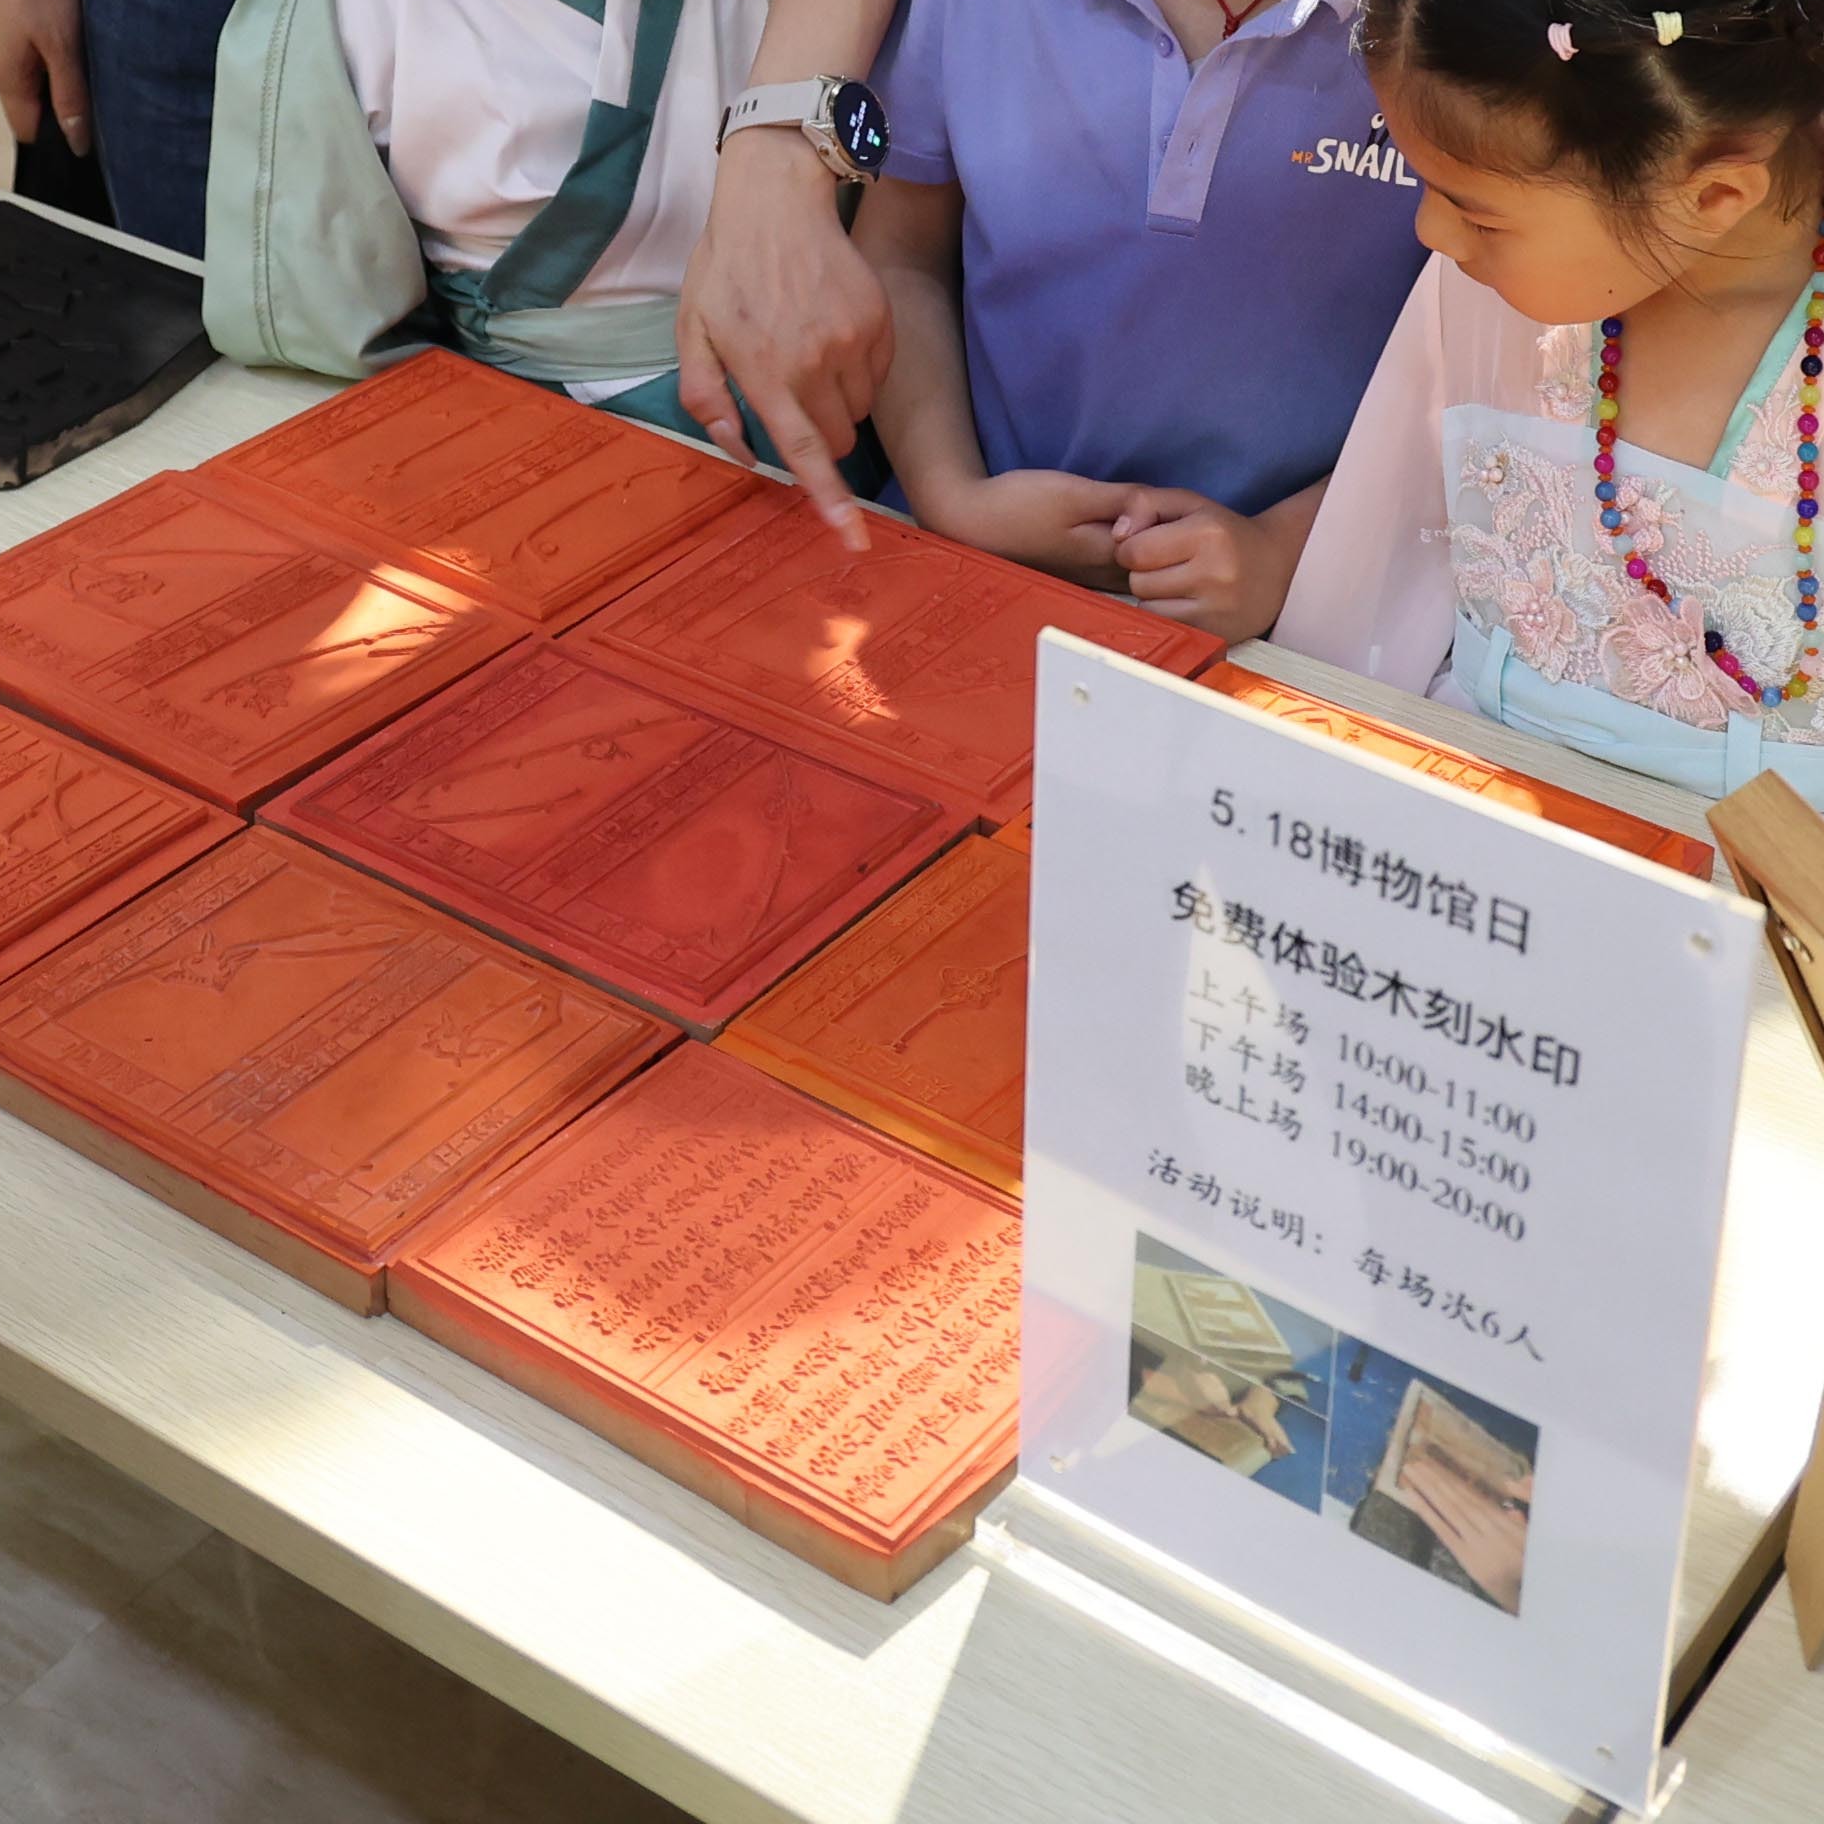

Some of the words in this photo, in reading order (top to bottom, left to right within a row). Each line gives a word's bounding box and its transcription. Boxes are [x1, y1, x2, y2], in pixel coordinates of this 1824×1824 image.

[1291, 150, 1314, 164] MR
[1307, 138, 1417, 187] SNAIL
[1171, 881, 1580, 1087] 免费体验木刻水印
[1189, 969, 1311, 1046] 上午场
[1338, 1033, 1537, 1145] 10:00-11:00
[1185, 1063, 1303, 1143] 晚上场
[1330, 1130, 1526, 1244] 19:00-20:00
[1188, 1016, 1307, 1095] 下午场
[1333, 1081, 1531, 1195] 14:00-15:00
[1352, 1247, 1545, 1364] 每场次6人
